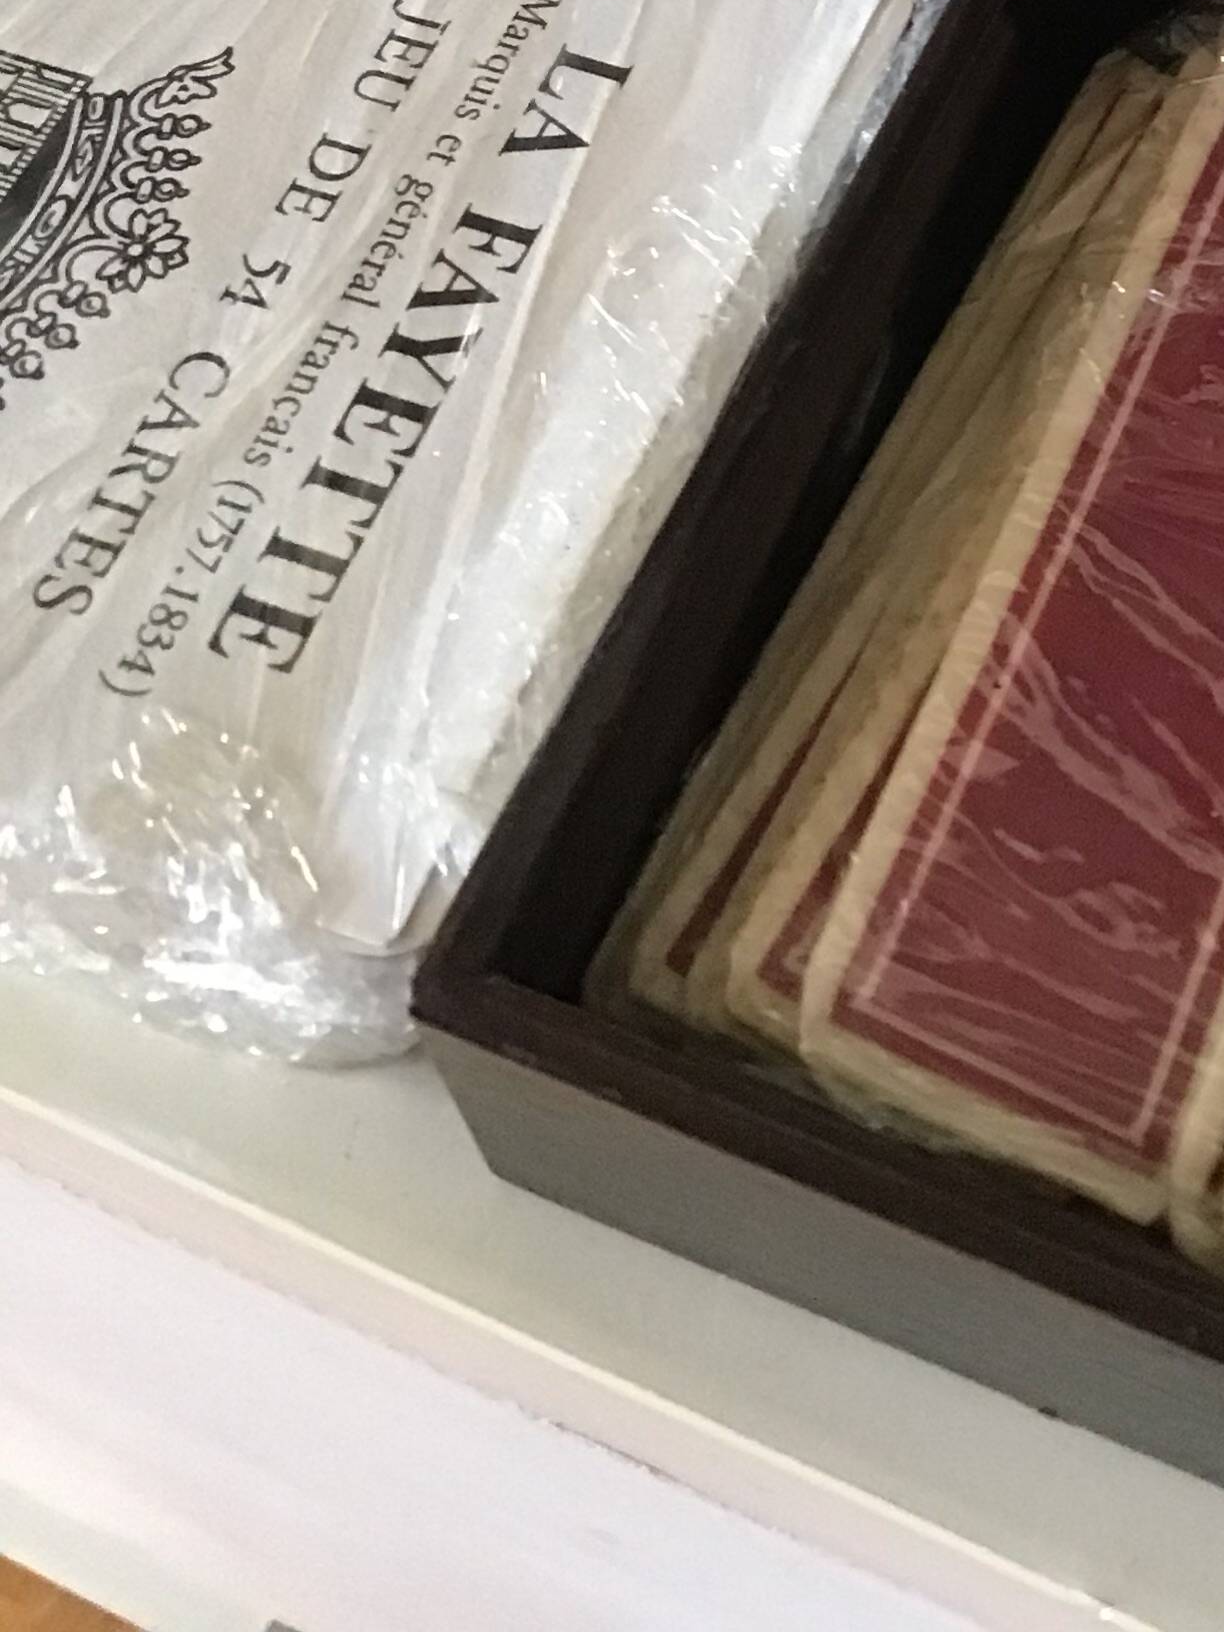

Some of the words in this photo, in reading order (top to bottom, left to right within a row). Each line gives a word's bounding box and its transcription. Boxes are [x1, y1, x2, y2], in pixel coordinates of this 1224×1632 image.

[426, 134, 462, 167] et
[499, 43, 635, 156] LA
[274, 132, 372, 223] DE
[341, 174, 434, 309] général
[218, 254, 292, 310] 54
[207, 202, 543, 674] FAYETTE
[244, 320, 359, 468] français
[32, 351, 231, 616] CARTES
[98, 480, 265, 697] (1757.1834)
